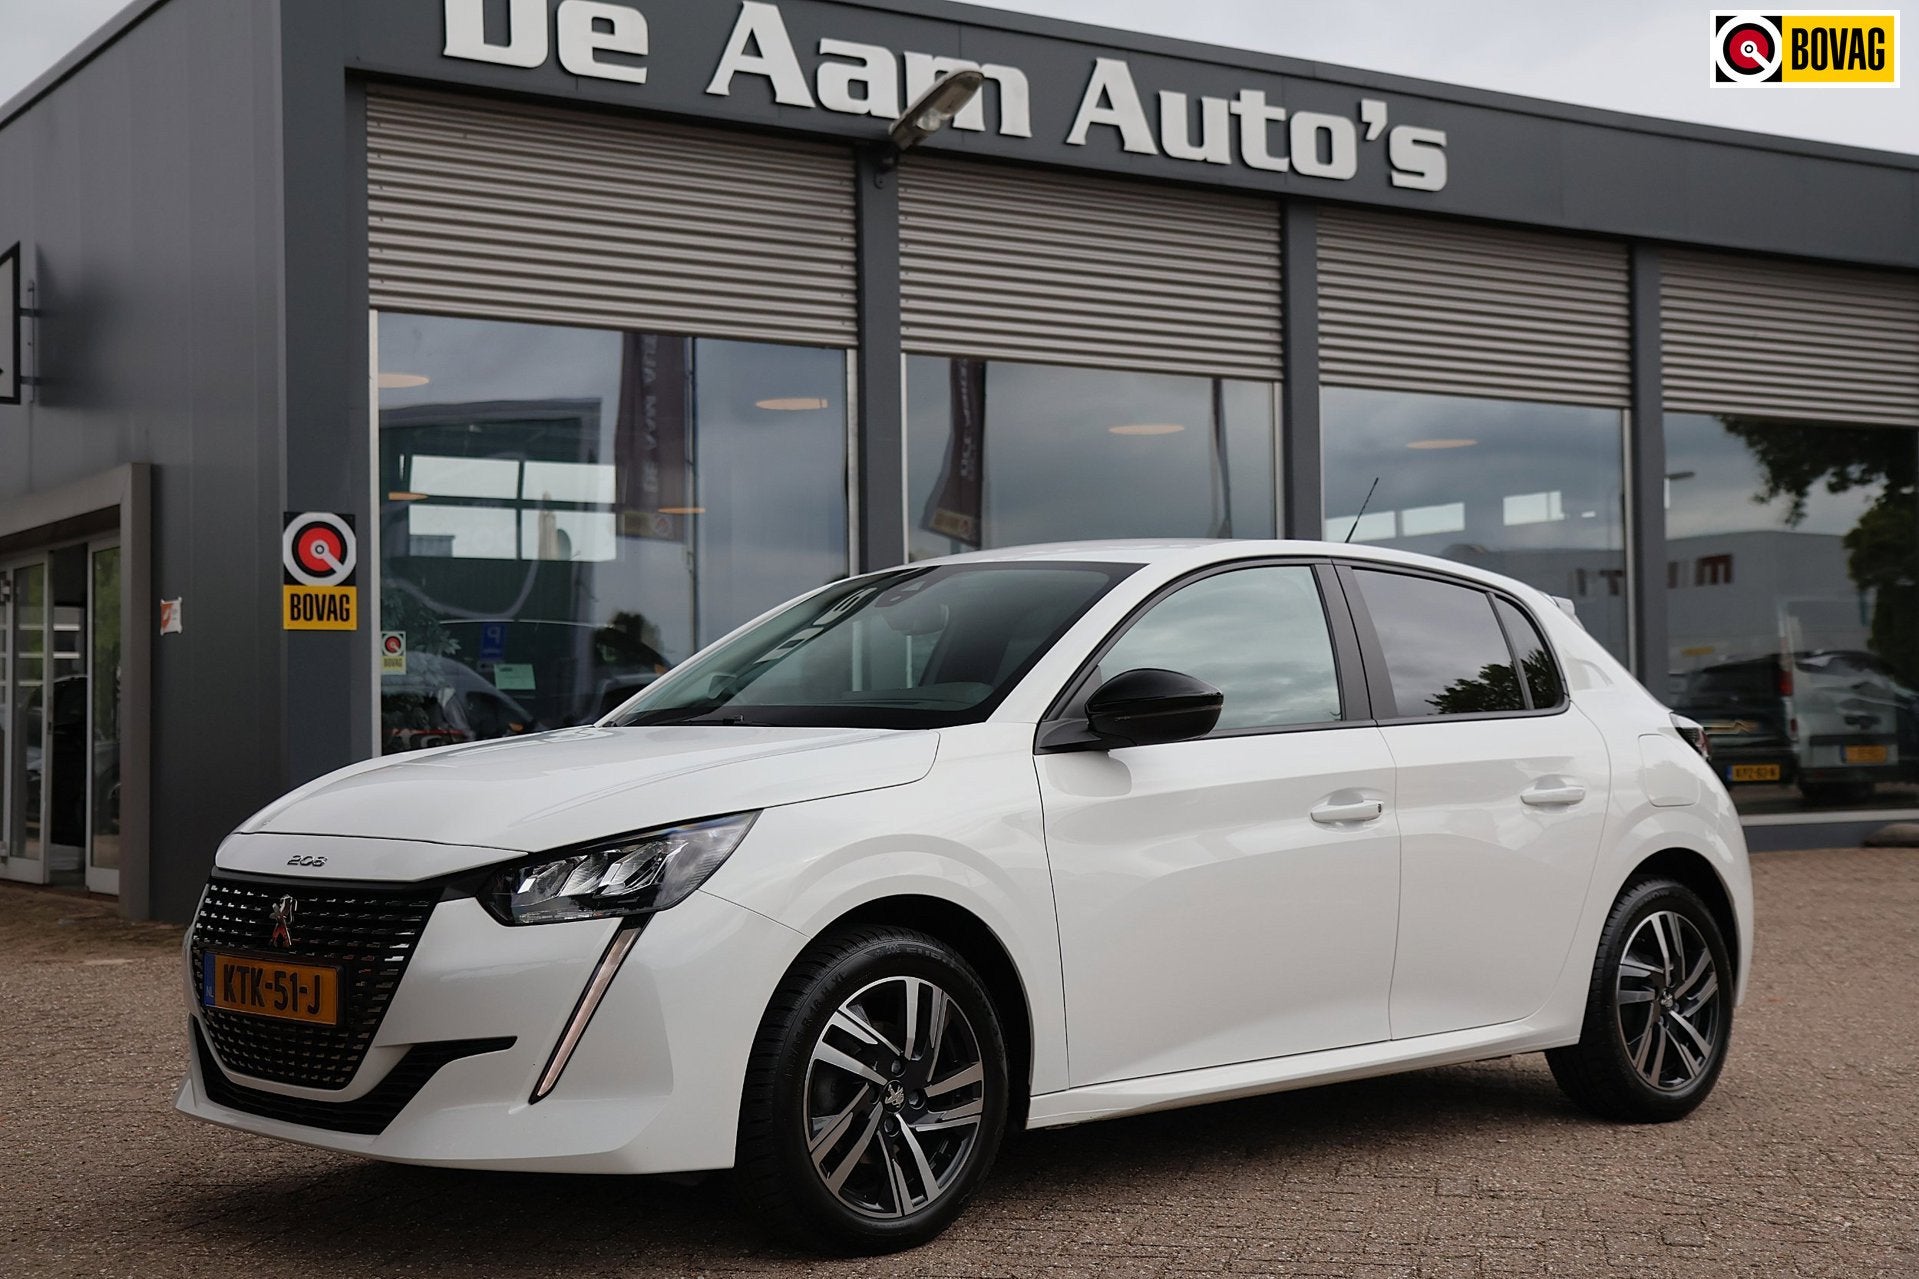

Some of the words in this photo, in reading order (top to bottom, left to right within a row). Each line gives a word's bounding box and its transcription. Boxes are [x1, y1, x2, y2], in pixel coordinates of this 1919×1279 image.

[443, 0, 648, 84] De
[706, 0, 1032, 138] Aam
[1066, 57, 1448, 192] Auto's
[290, 593, 350, 622] BOVAG
[383, 658, 403, 668] BOVAG
[287, 855, 328, 867] 208
[223, 963, 321, 1015] KTK-51-J
